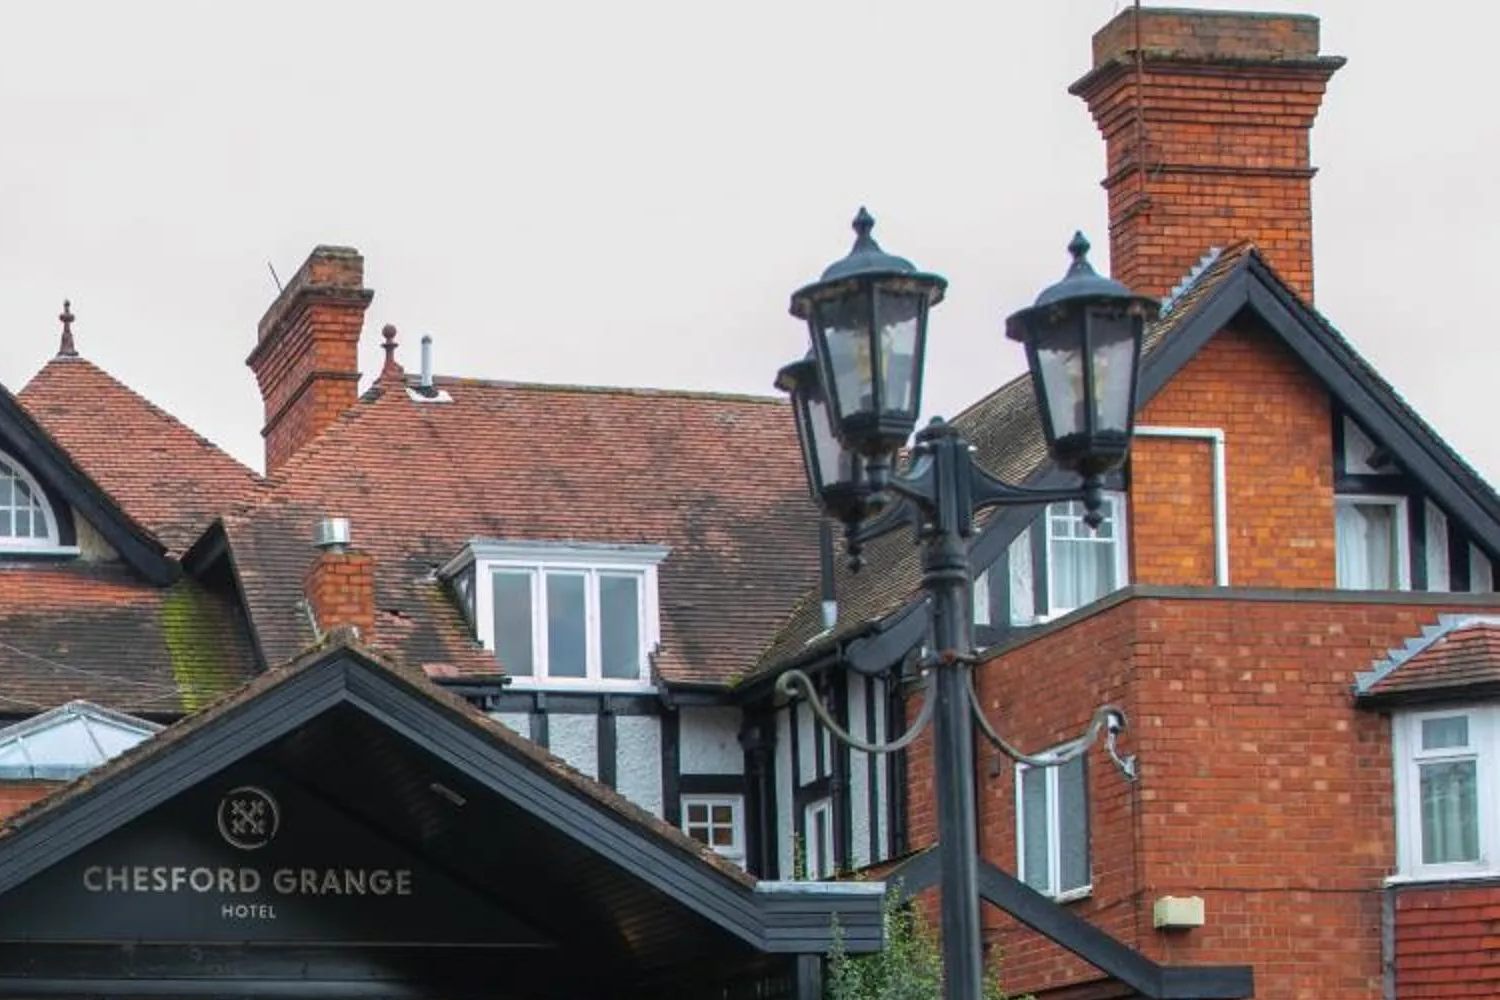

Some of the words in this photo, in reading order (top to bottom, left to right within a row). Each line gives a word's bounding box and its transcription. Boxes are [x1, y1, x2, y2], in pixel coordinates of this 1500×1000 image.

[84, 866, 261, 894] CHESFORD
[274, 868, 413, 897] GRANGE
[222, 904, 277, 920] HOTEL
